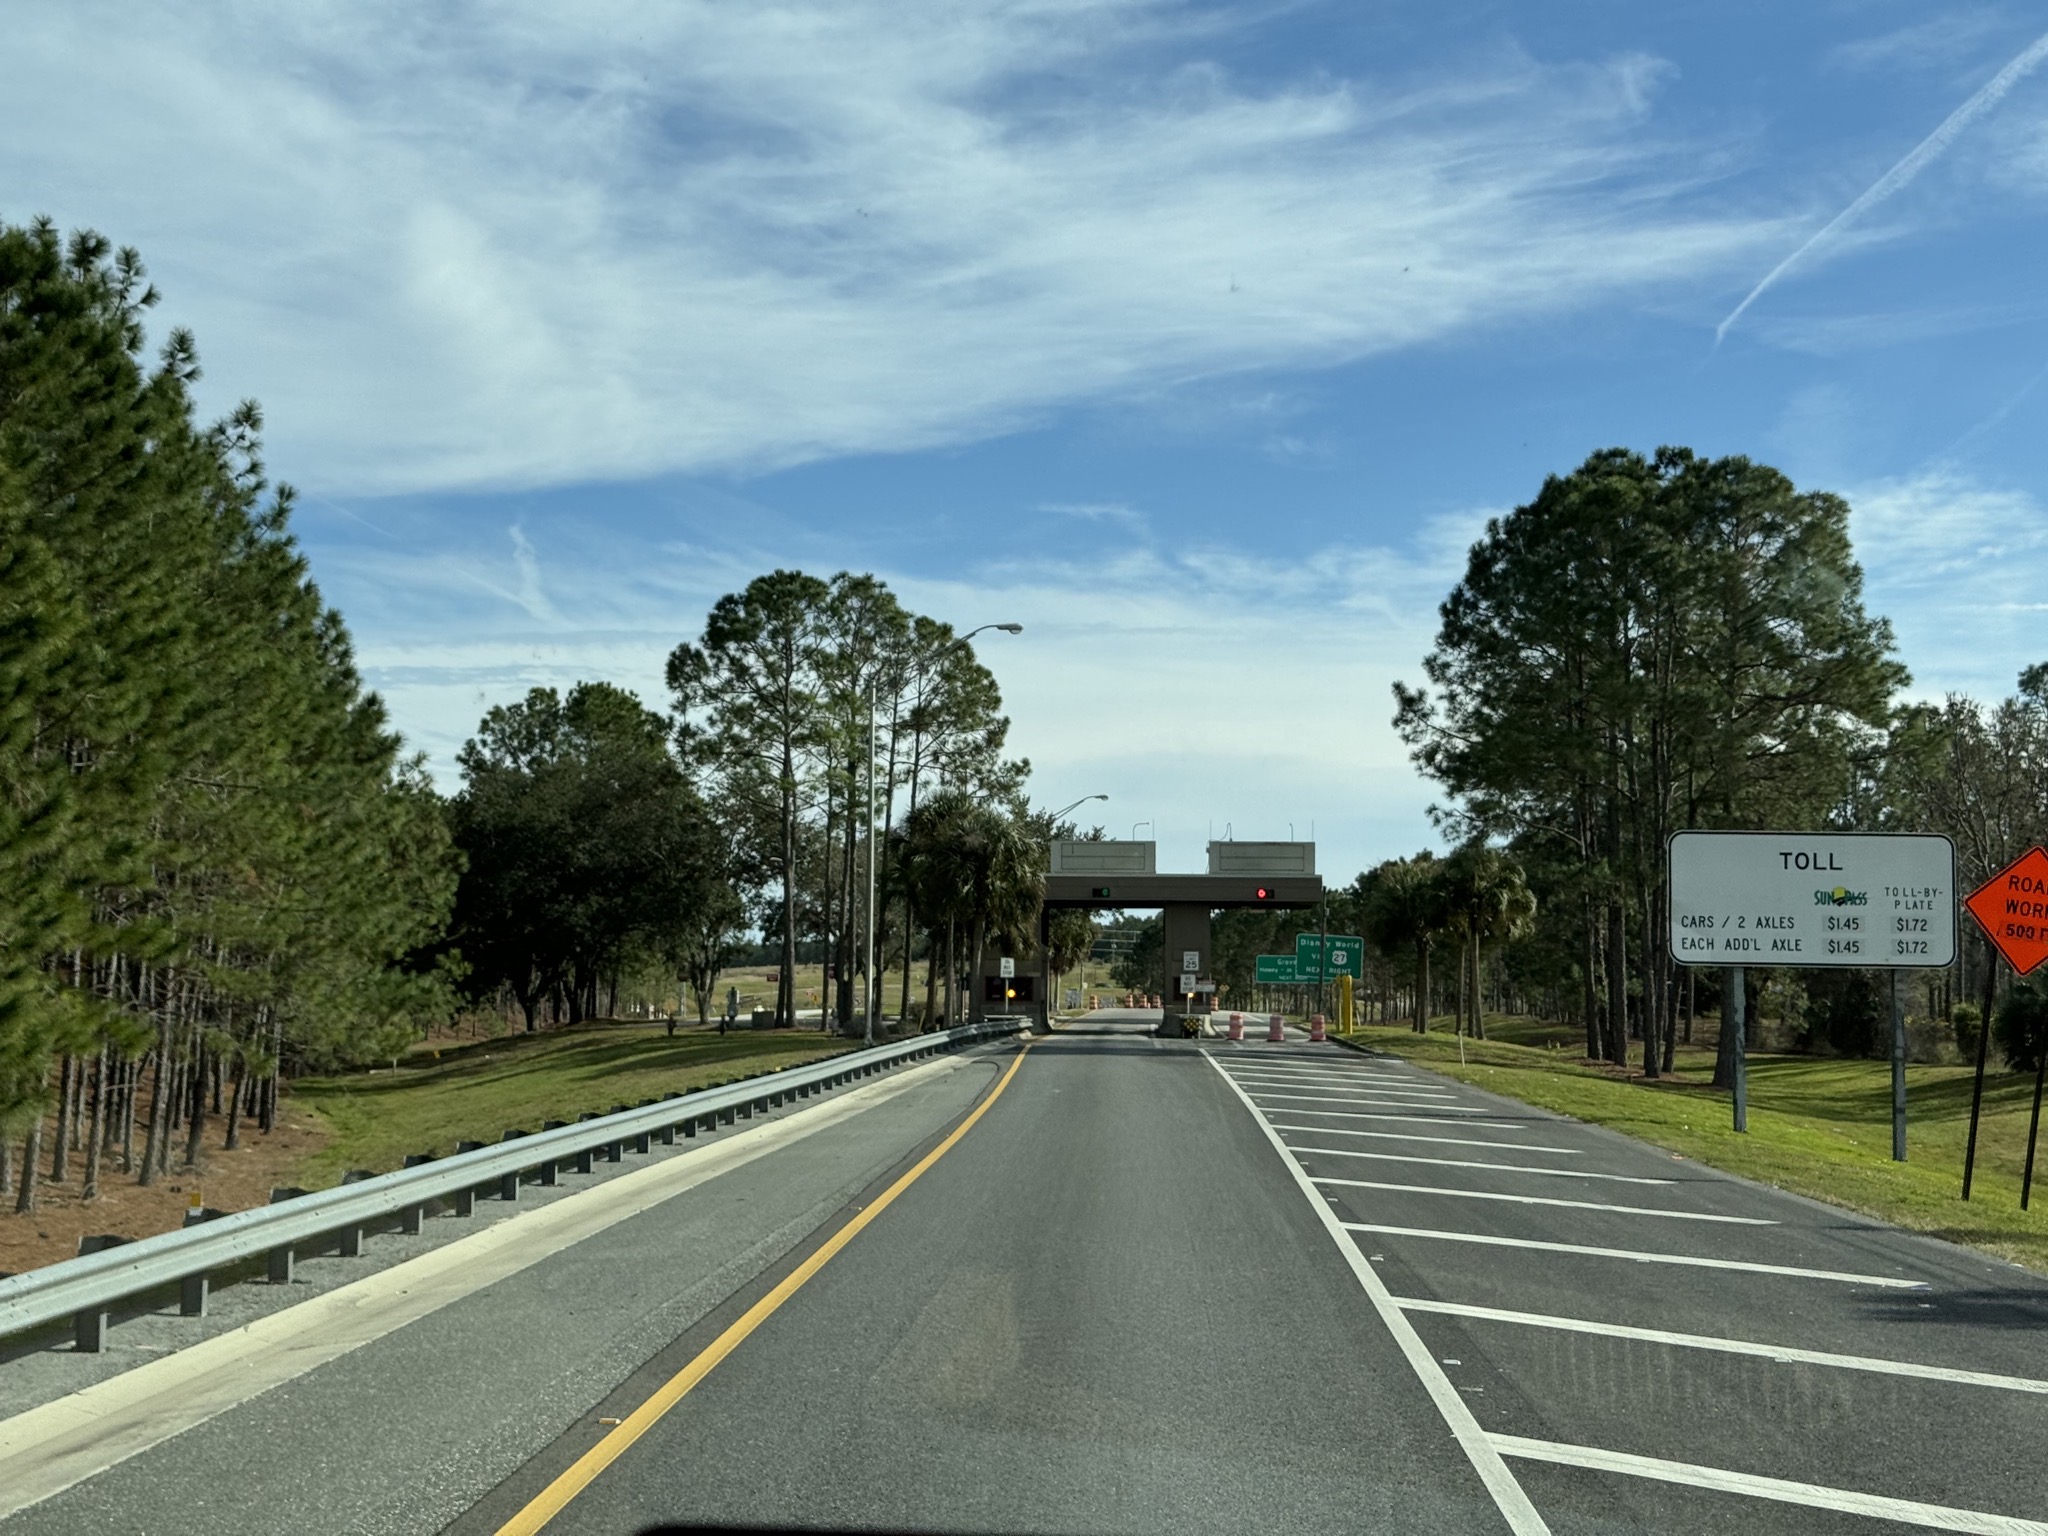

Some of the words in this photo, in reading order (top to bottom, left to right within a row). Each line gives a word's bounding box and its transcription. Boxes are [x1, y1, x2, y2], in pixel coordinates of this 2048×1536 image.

[1779, 852, 1843, 871] TOLL
[2008, 874, 2048, 895] ROA
[1894, 900, 1934, 910] PLATE
[1681, 915, 1714, 928] CARS
[1722, 915, 1730, 929] /
[1738, 916, 1746, 928] 2
[1756, 916, 1795, 929] AXLES
[1827, 916, 1860, 931] $1.45
[1896, 917, 1928, 932] $1.72
[2006, 923, 2036, 940] 500
[1300, 939, 1331, 948] Disny
[1335, 940, 1360, 949] World
[1681, 937, 1714, 950] EACH
[1724, 938, 1761, 951] ADD'L
[1771, 938, 1802, 951] AXLE
[1828, 939, 1860, 954] $1.45
[1897, 939, 1928, 955] $1.72
[1185, 960, 1198, 968] 25
[1333, 953, 1346, 963] 27
[1328, 967, 1352, 975] RIGHT
